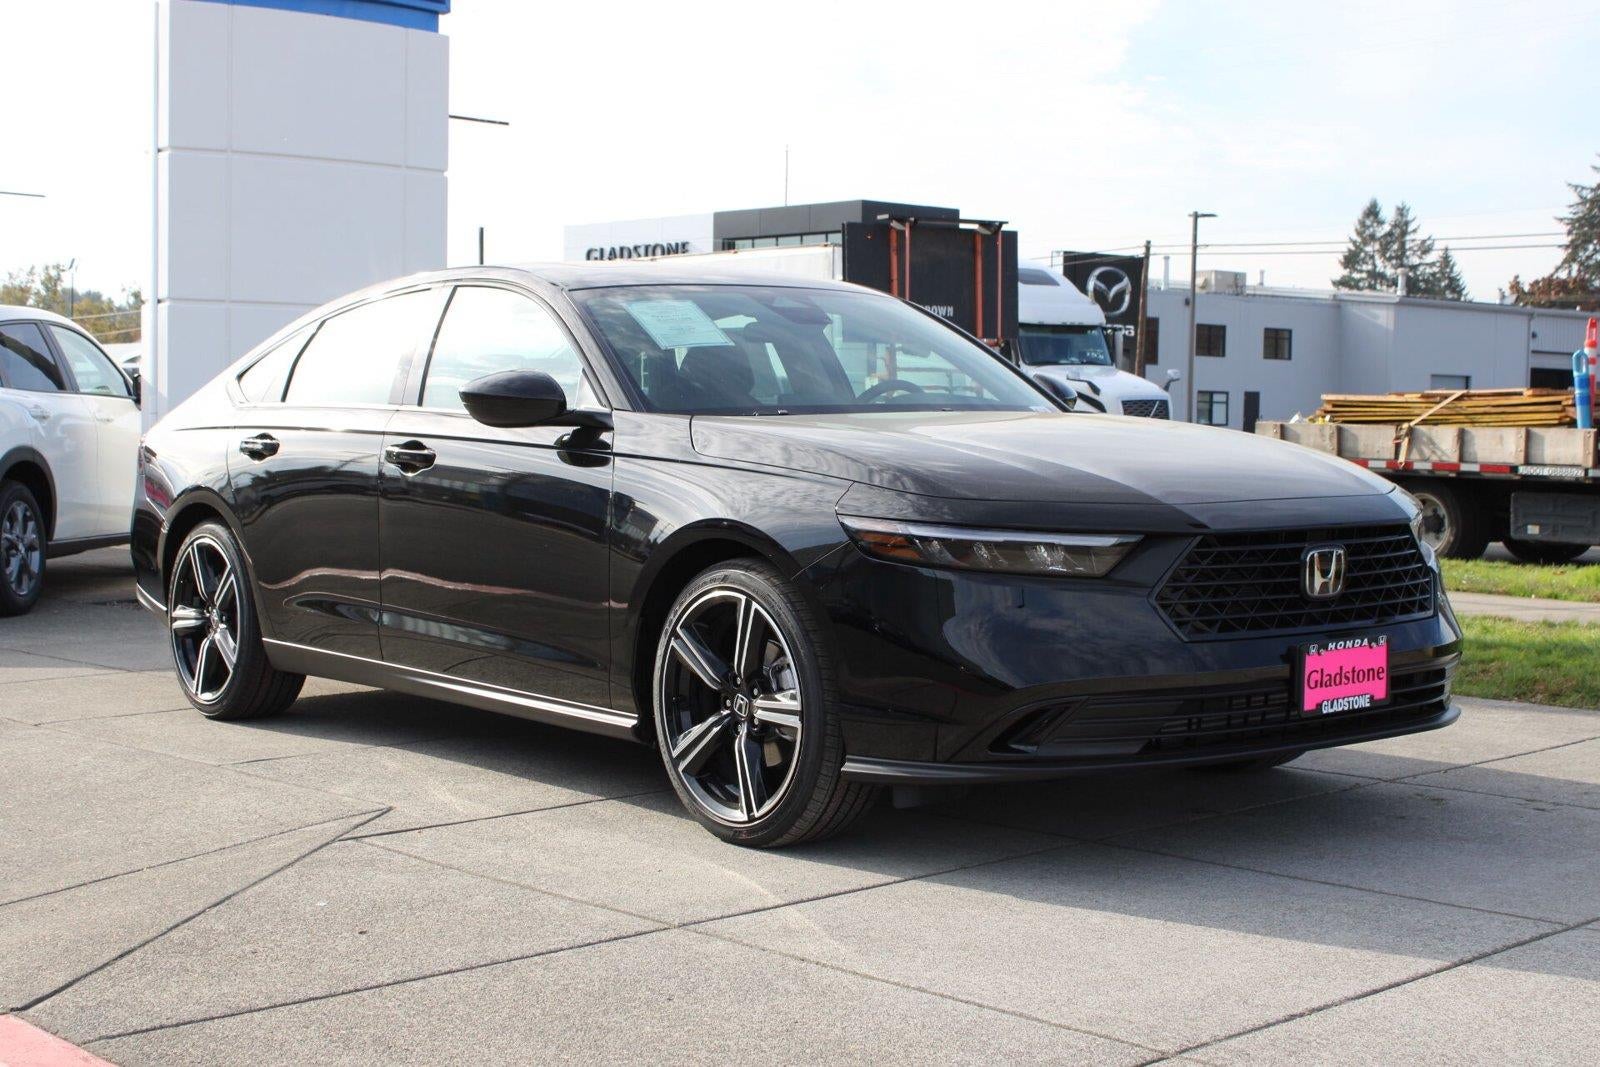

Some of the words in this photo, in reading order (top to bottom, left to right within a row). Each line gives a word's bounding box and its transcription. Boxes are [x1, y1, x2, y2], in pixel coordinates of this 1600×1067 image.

[586, 241, 689, 261] GLADSTONE
[1328, 638, 1369, 651] HONDA
[1307, 665, 1385, 690] Gladstone
[1322, 695, 1371, 714] GLADSTONE
